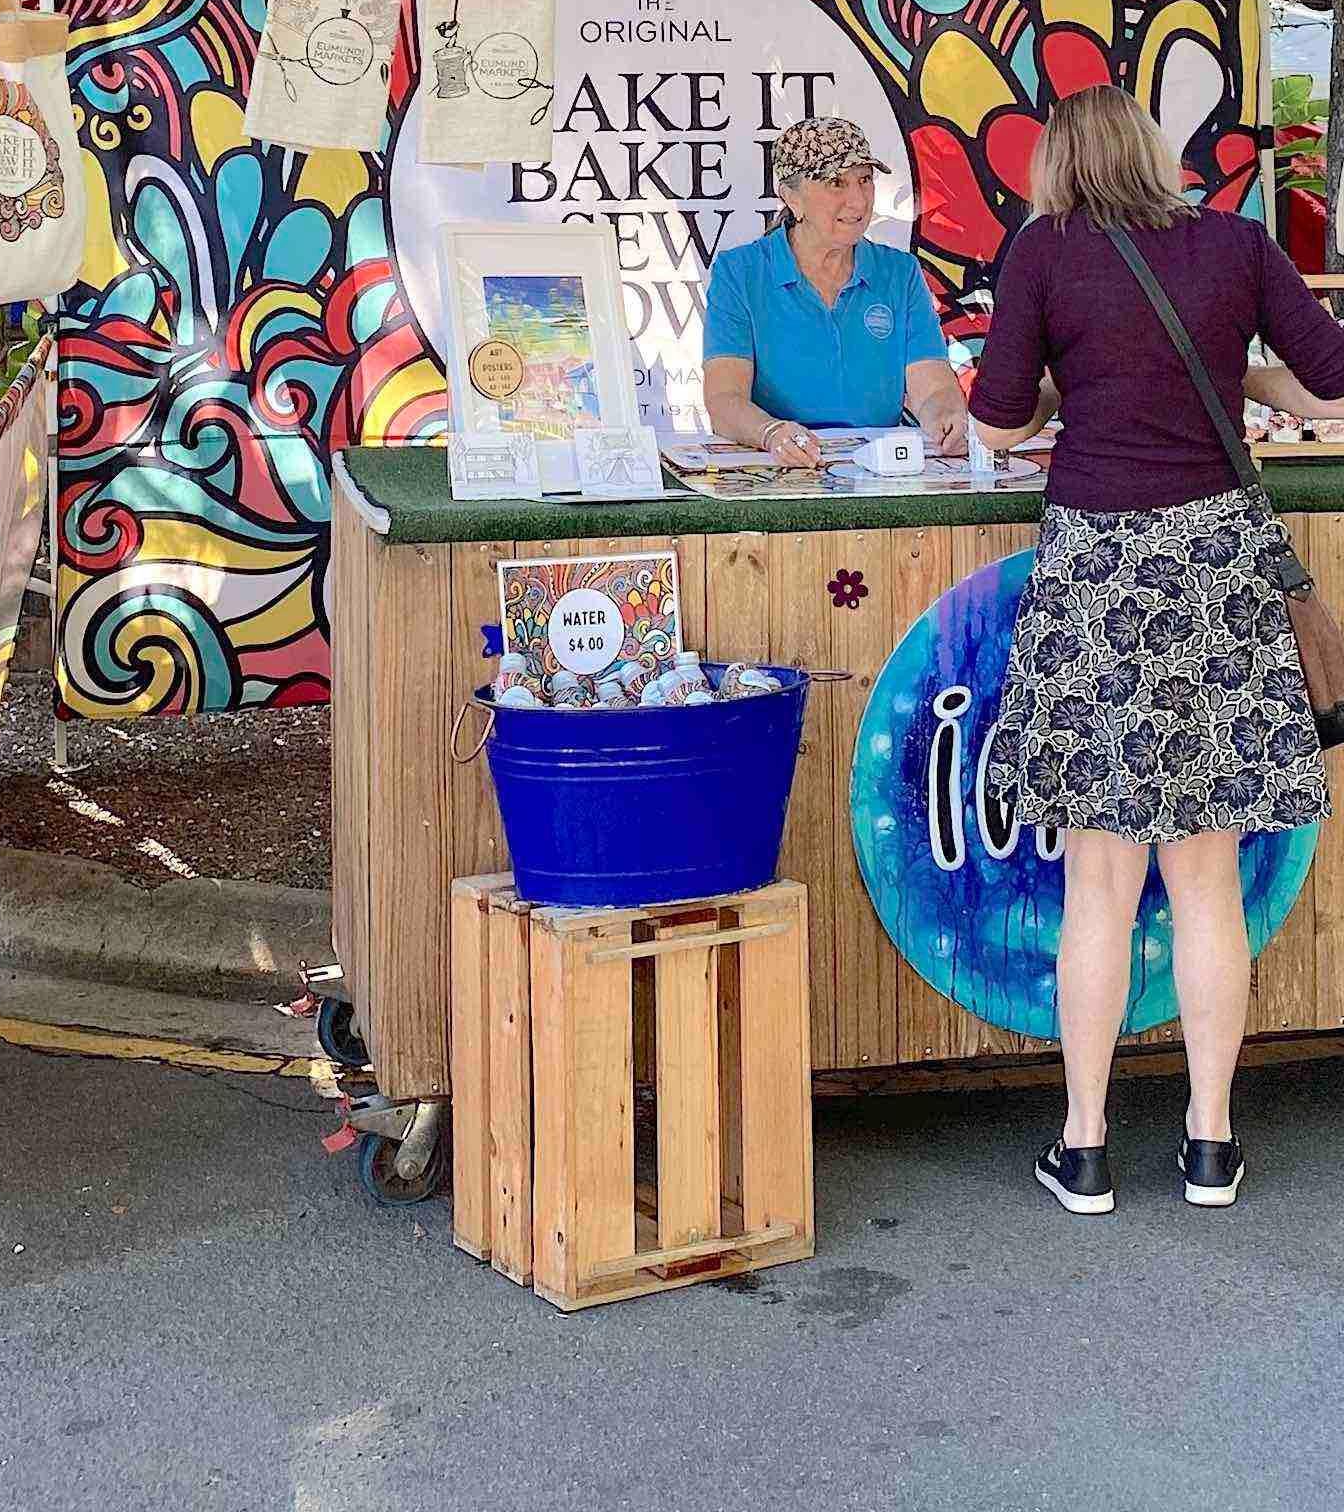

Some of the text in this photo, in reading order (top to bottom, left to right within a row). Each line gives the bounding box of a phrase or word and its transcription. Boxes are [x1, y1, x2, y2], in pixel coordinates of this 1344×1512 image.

[580, 20, 733, 43] ORIGINAL
[553, 72, 836, 133] AKE IT
[507, 141, 780, 204] BAKE I
[562, 210, 735, 272] EW
[562, 610, 606, 627] WATER
